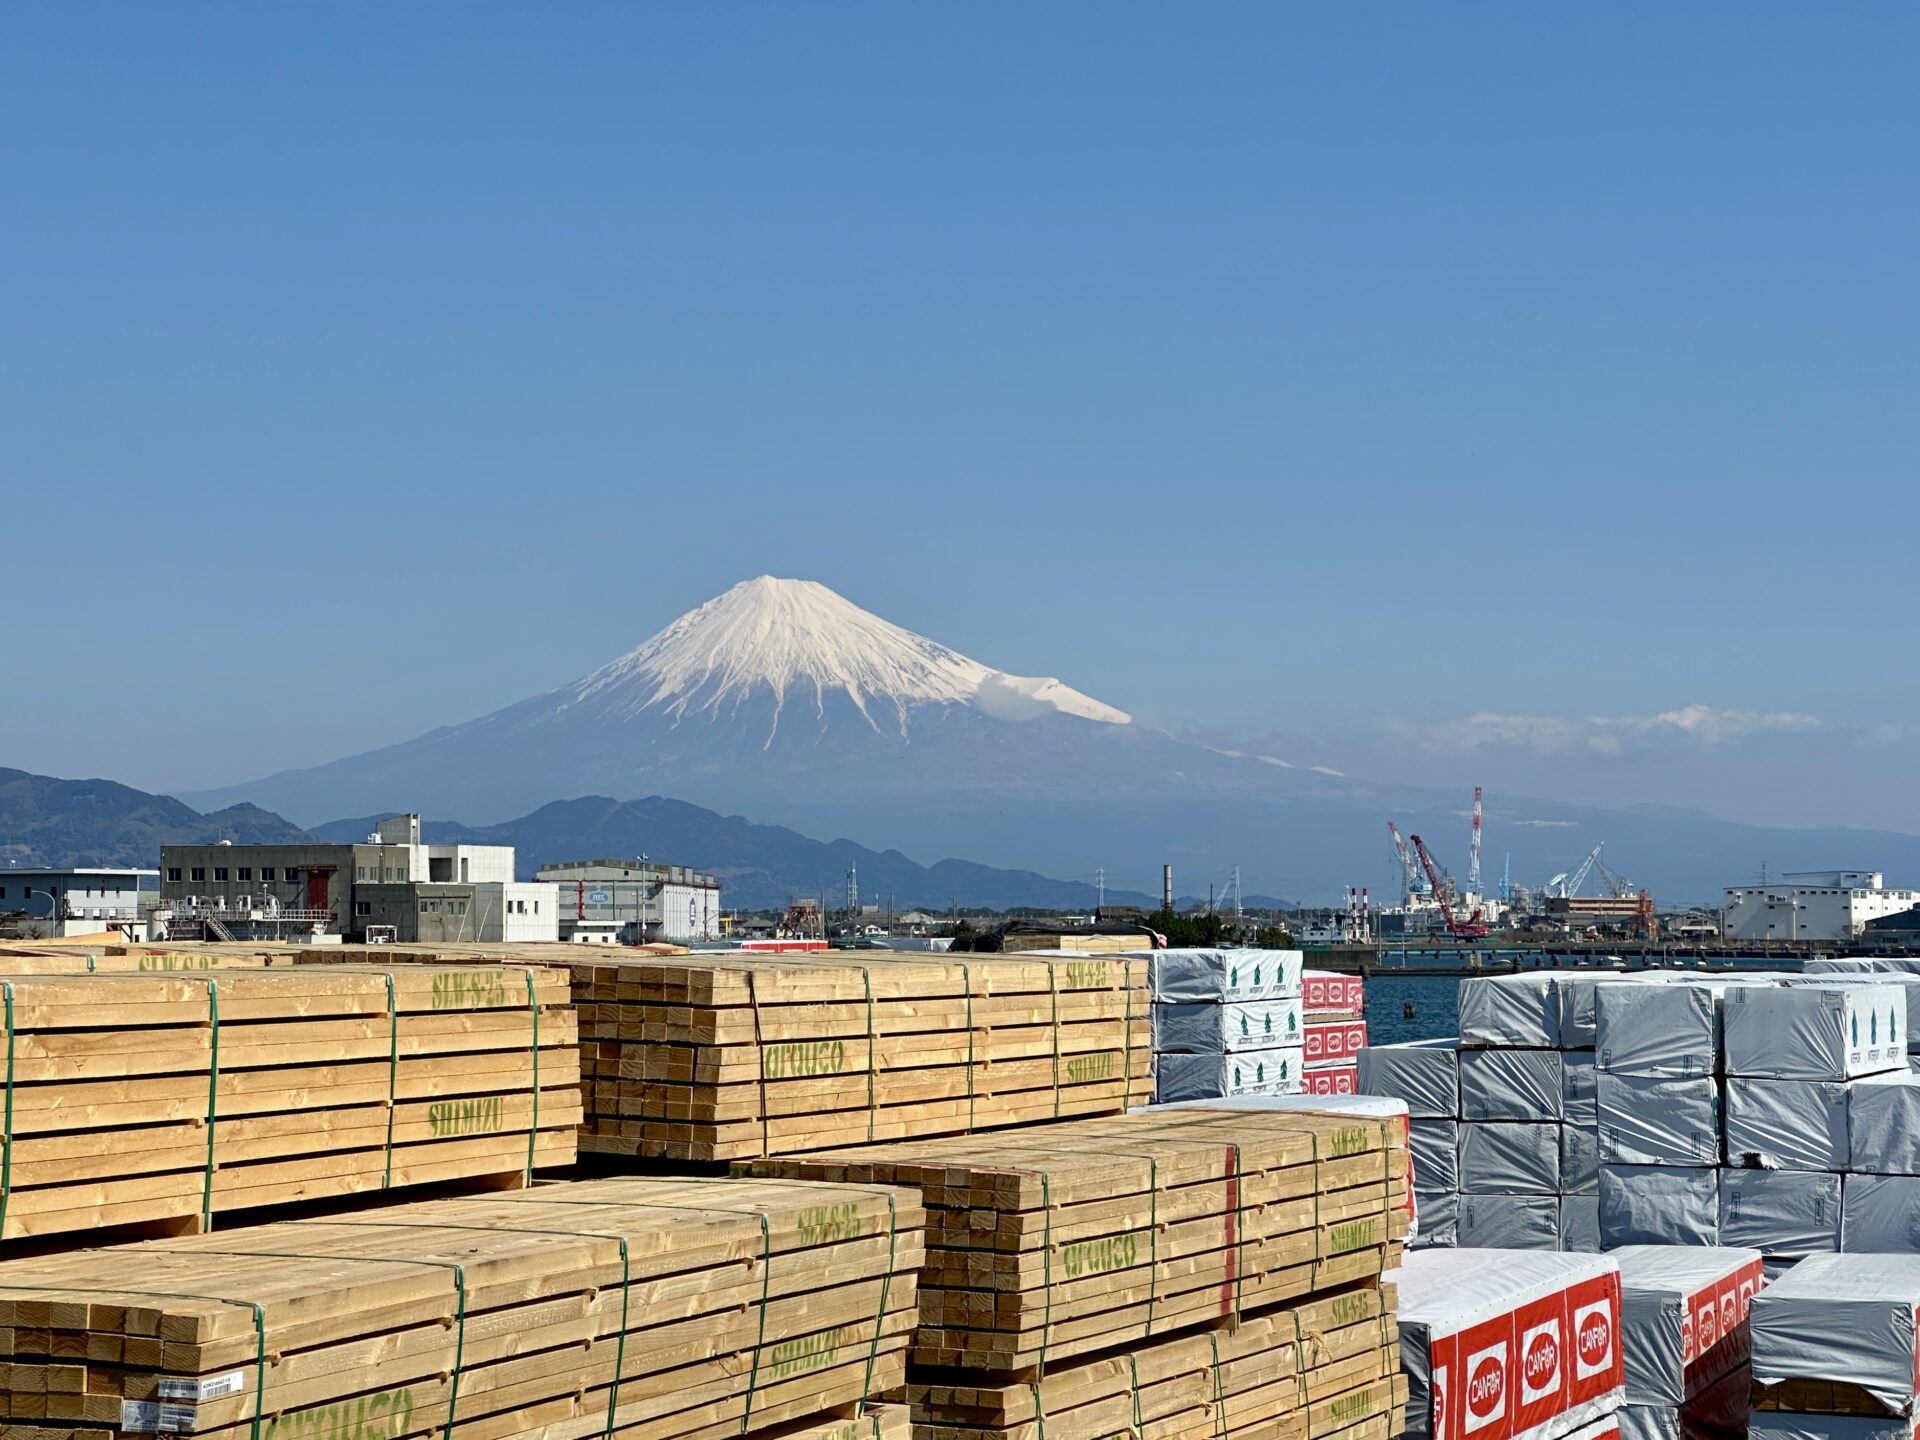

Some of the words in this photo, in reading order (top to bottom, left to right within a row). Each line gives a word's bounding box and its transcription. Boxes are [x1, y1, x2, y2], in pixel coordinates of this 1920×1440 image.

[432, 972, 504, 1009] SLW-S-25
[1066, 961, 1106, 989] SLW-S-25
[765, 1041, 844, 1078] arauco
[1067, 1053, 1114, 1083] SHIMIZU
[428, 1097, 503, 1138] SHIMIZU
[1064, 1234, 1136, 1278] arauco
[769, 1328, 839, 1380] SHIMIZU
[1580, 1326, 1608, 1354] CANFOR
[1527, 1344, 1556, 1377] CANFOR
[1471, 1368, 1501, 1404] CANFOR
